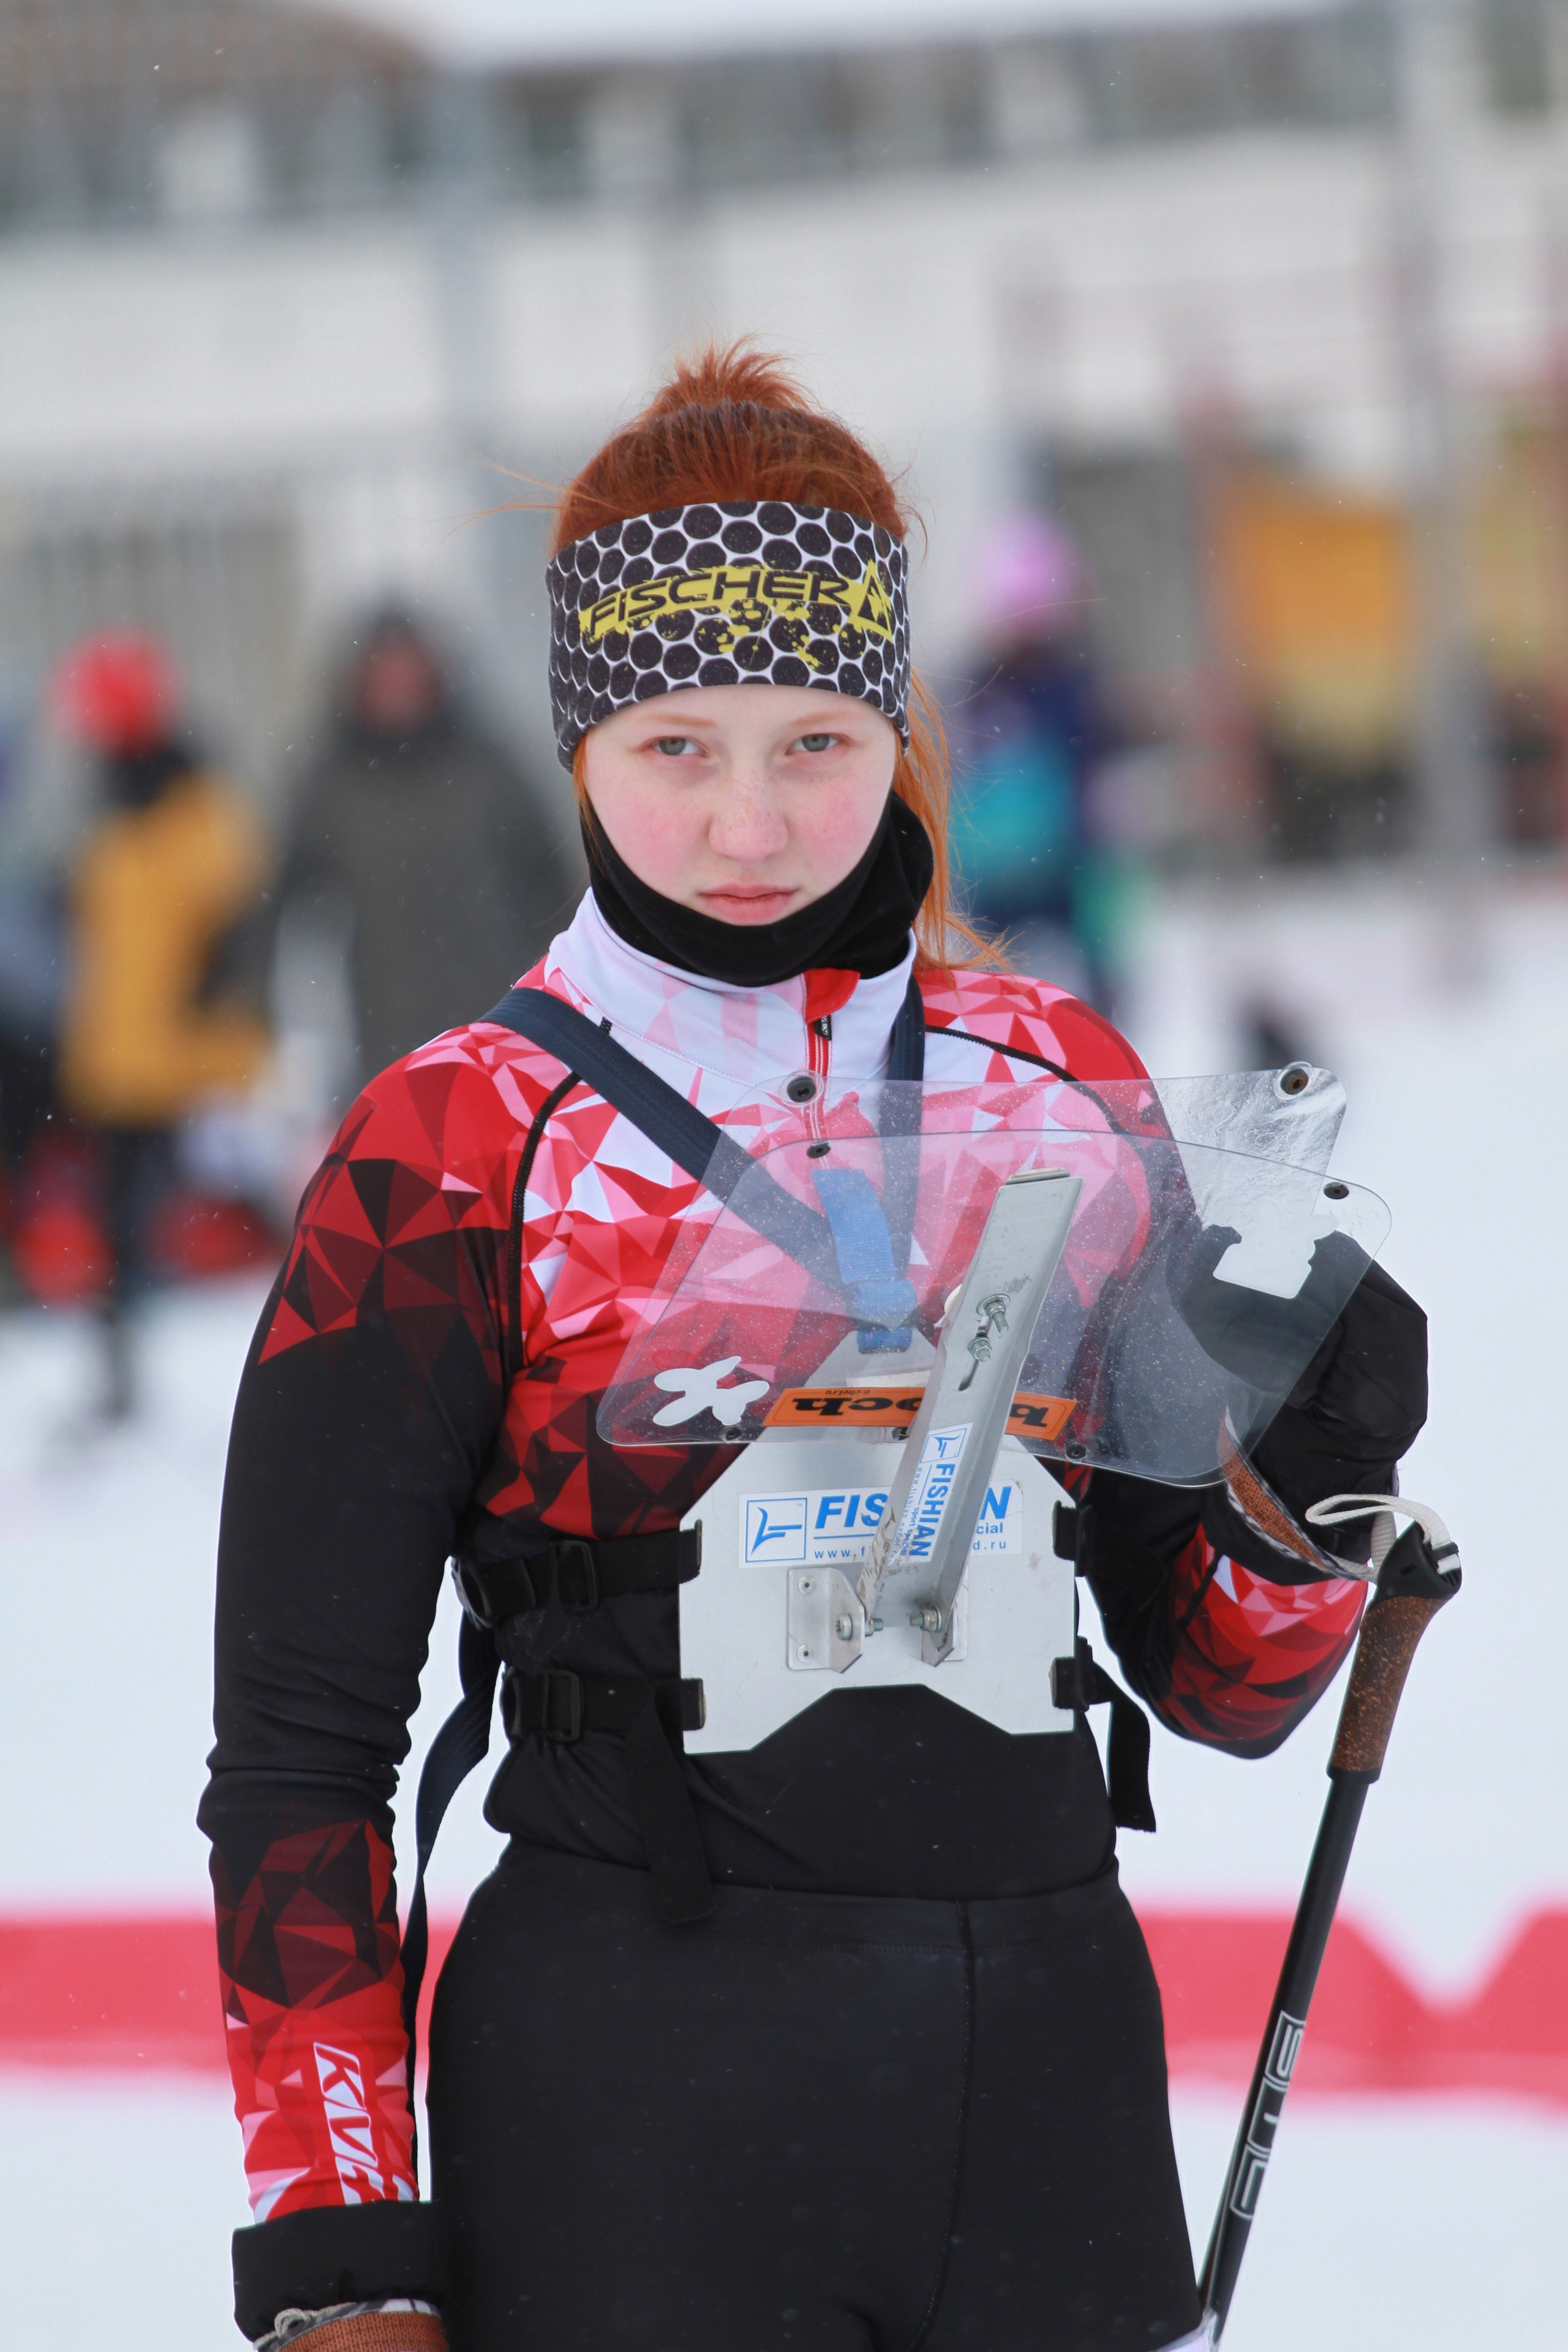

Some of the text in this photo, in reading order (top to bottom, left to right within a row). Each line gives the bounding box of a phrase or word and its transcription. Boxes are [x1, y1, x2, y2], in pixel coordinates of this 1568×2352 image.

[590, 570, 851, 636] FISCHER
[908, 1463, 956, 1556] FISHIAN
[910, 1507, 919, 1527] sport
